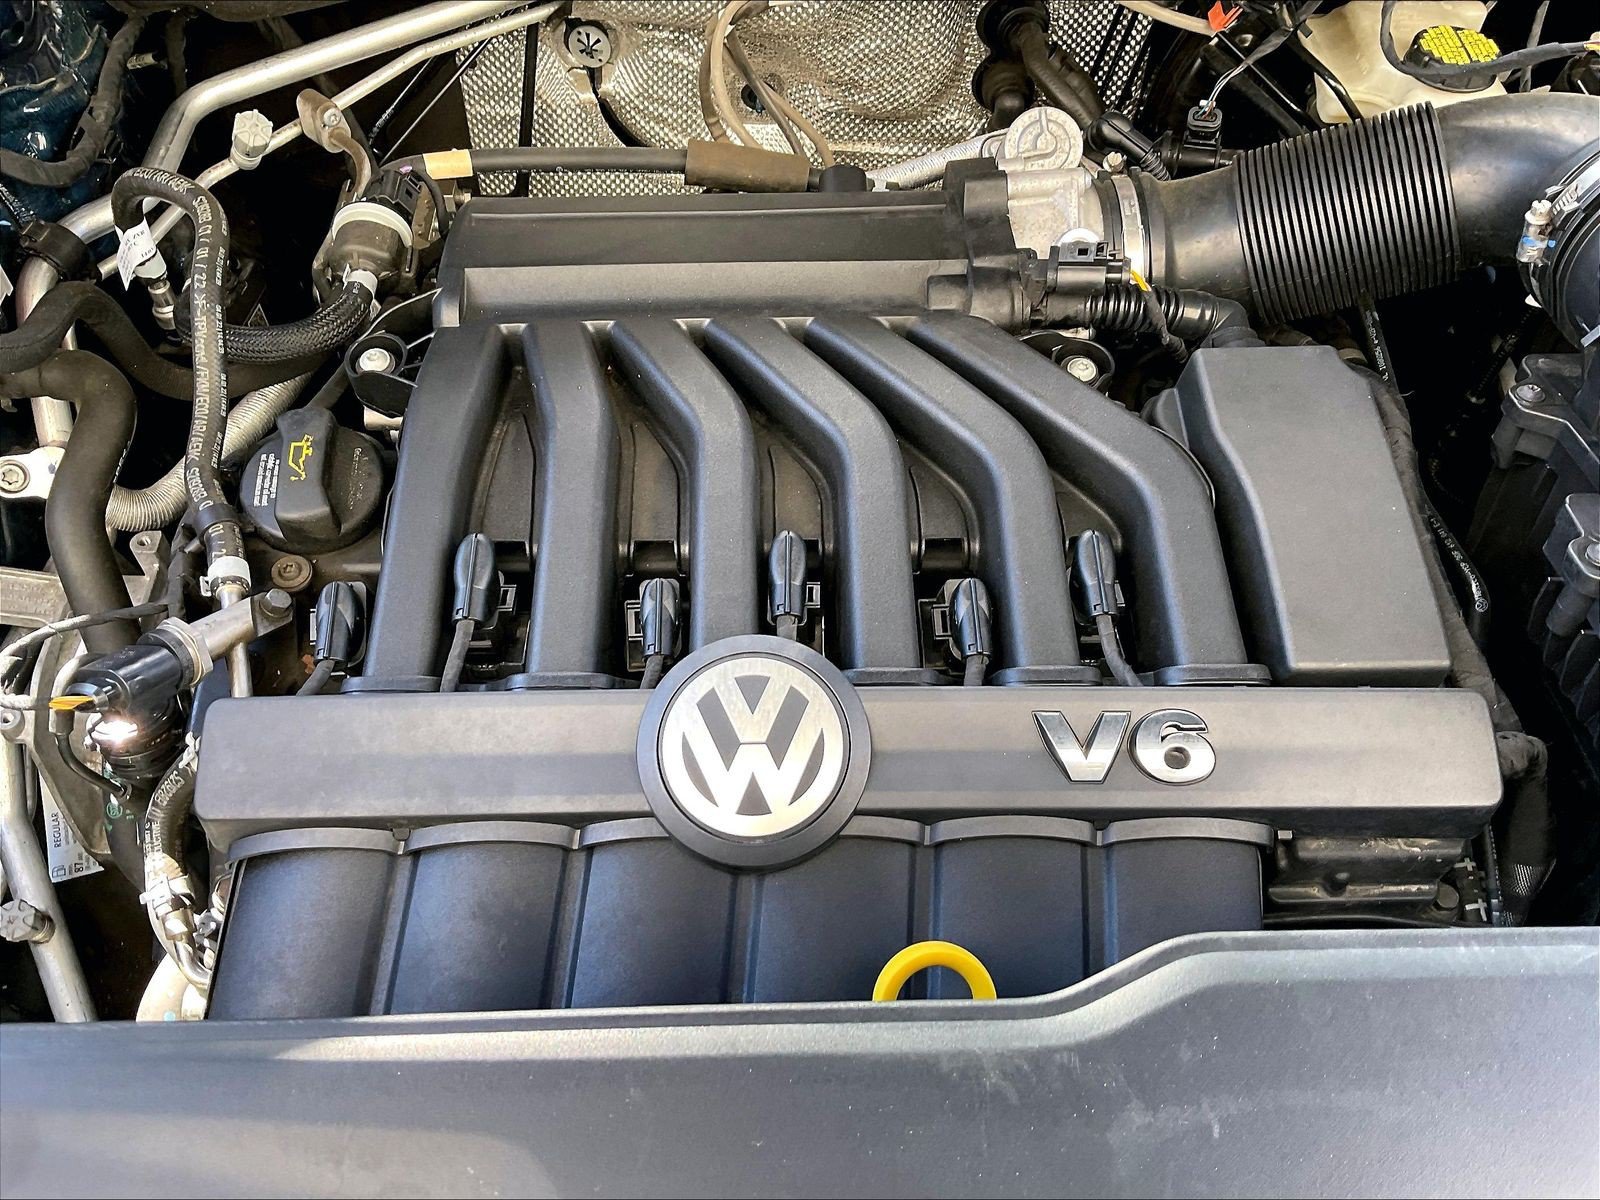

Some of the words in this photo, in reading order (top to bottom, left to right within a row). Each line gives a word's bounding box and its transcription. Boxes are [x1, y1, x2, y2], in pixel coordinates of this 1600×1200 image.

[1031, 708, 1217, 786] V6
[53, 812, 62, 848] REGULAR
[74, 862, 84, 873] 87
